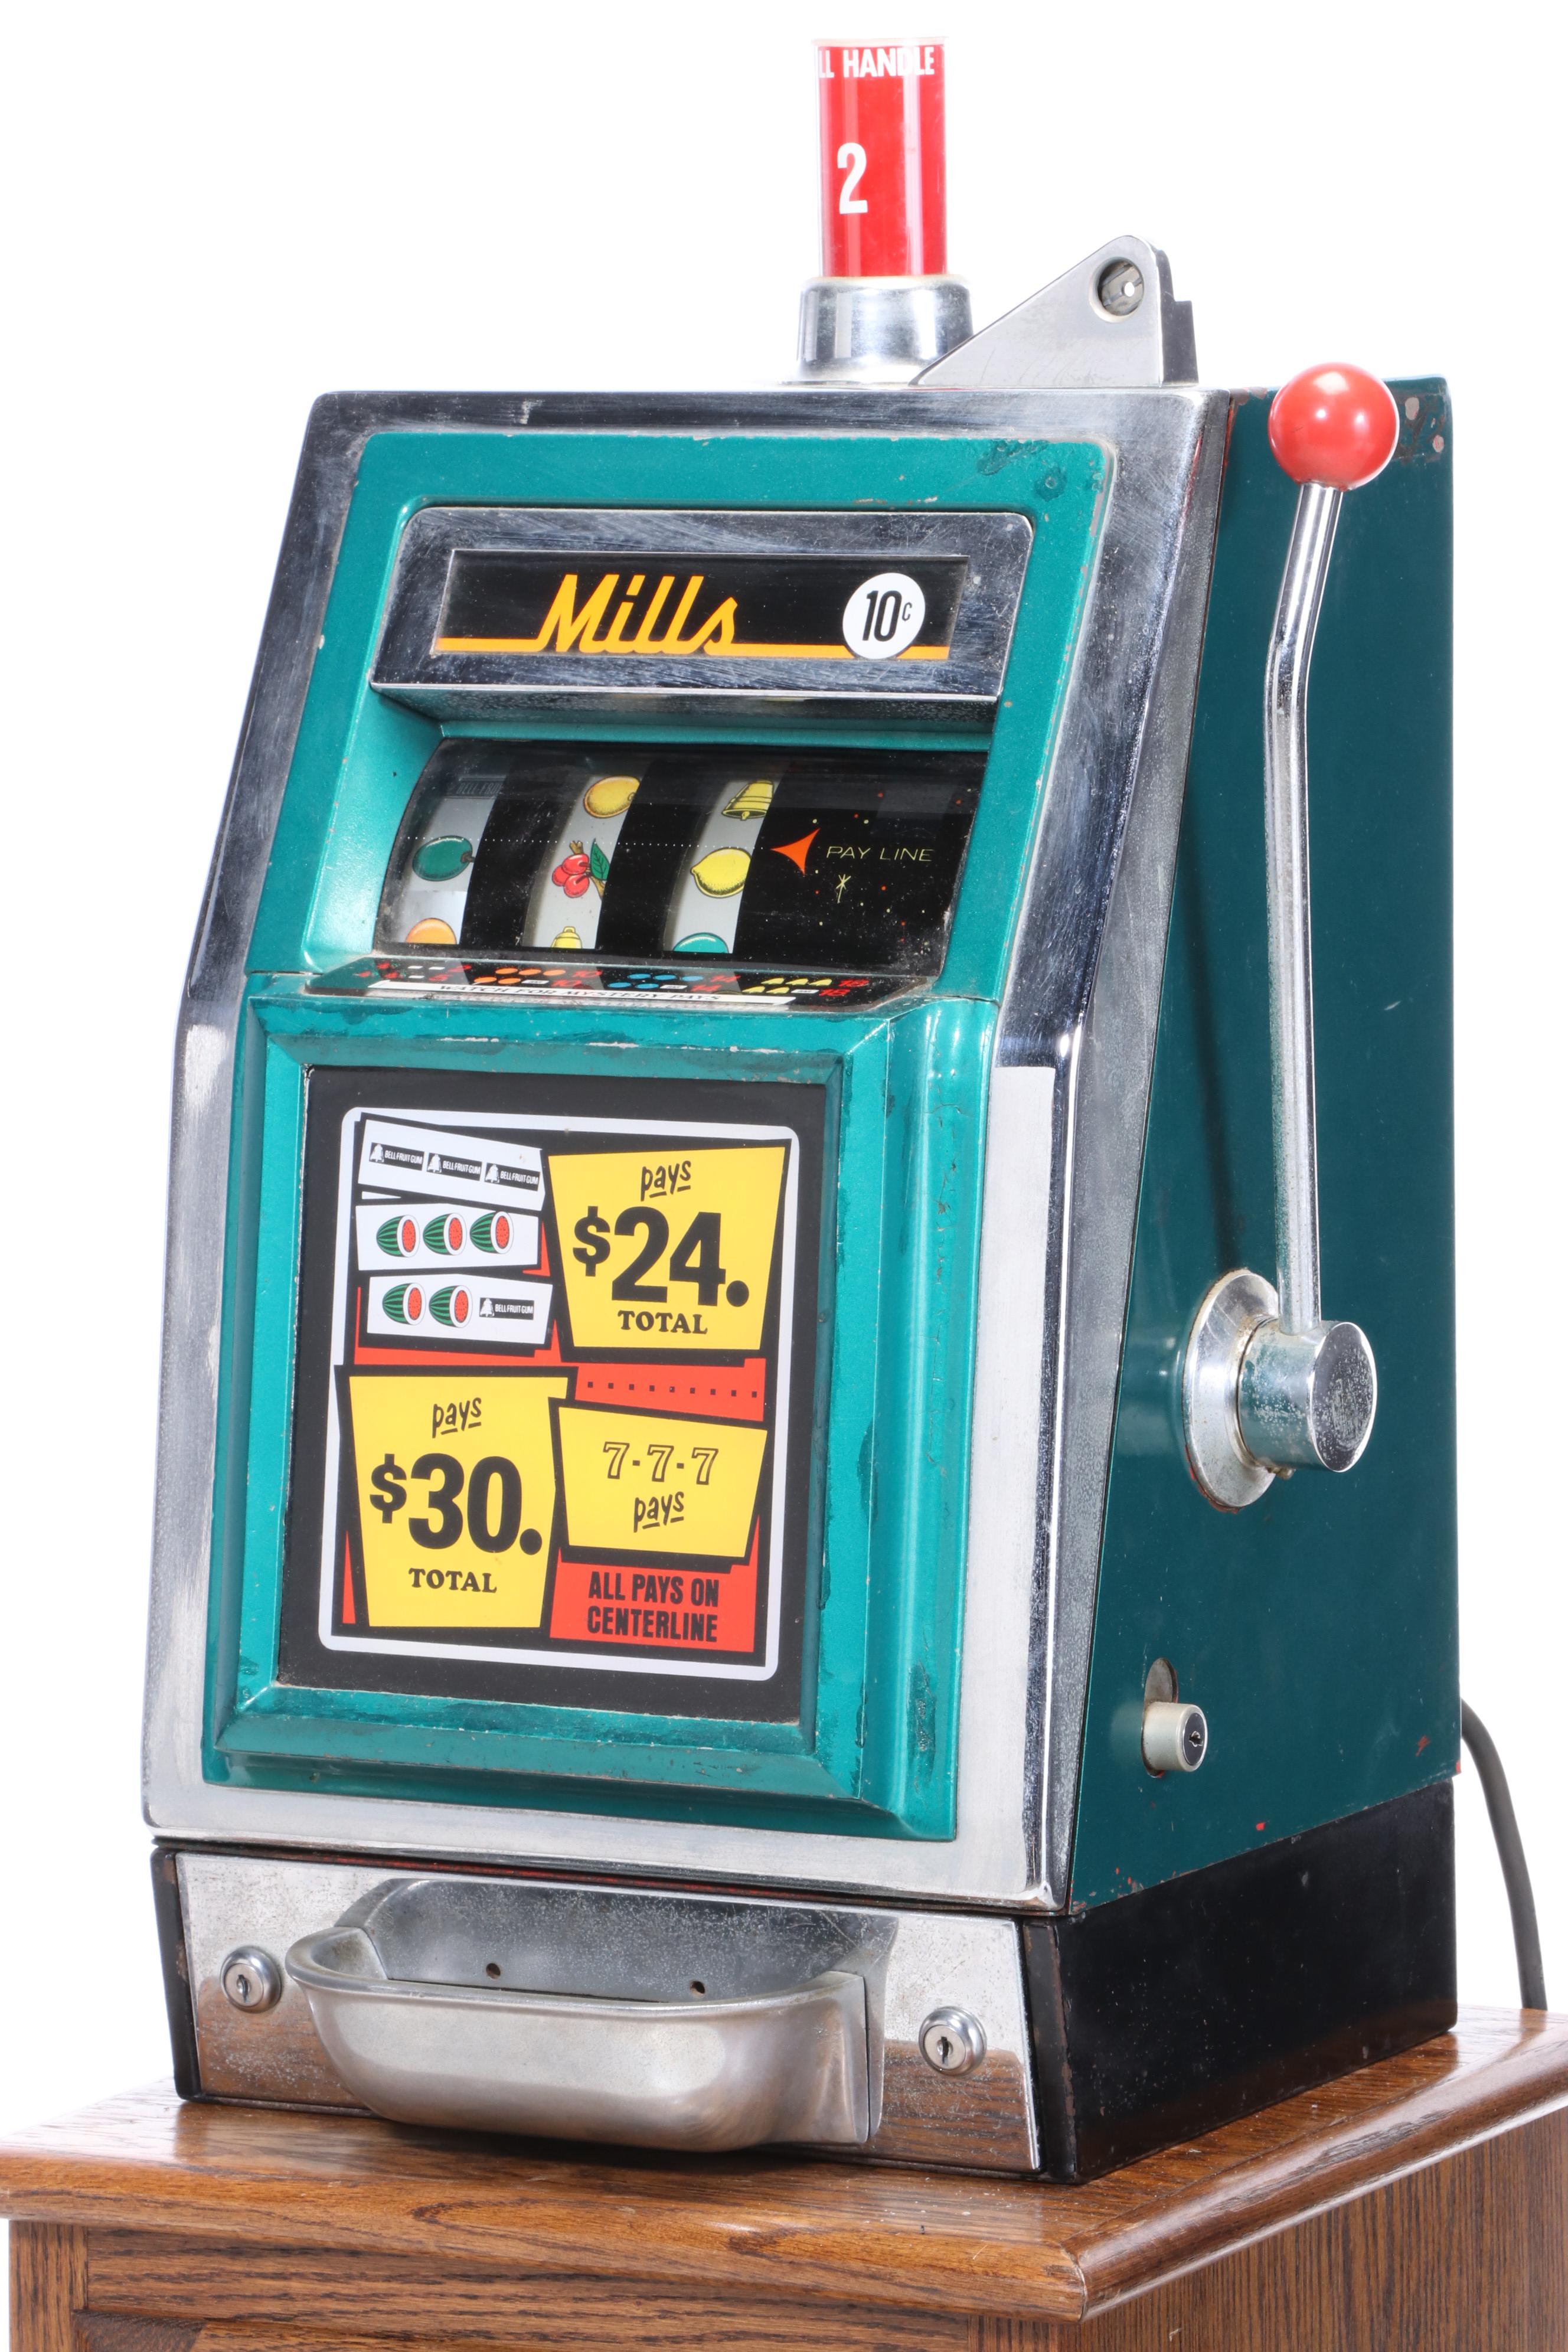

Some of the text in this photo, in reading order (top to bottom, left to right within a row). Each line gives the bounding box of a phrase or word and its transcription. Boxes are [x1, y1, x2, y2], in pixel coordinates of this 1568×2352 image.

[842, 46, 935, 79] HANDLE
[837, 142, 868, 214] 2
[533, 573, 738, 656] Mills
[827, 845, 935, 862] PAY LINE
[440, 985, 508, 993] WATCH
[563, 991, 663, 999] MYSTERY
[641, 1160, 691, 1201] pays
[572, 1206, 750, 1307] $24.
[618, 1309, 708, 1335] TOTAL
[432, 1397, 482, 1439] pays
[602, 1441, 719, 1485] 7-7-7
[369, 1452, 543, 1556] $30.
[633, 1491, 685, 1533] pays
[408, 1567, 497, 1594] TOTAL
[588, 1570, 720, 1608] ALL PAYS ON
[586, 1605, 718, 1643] CENTERLINE
